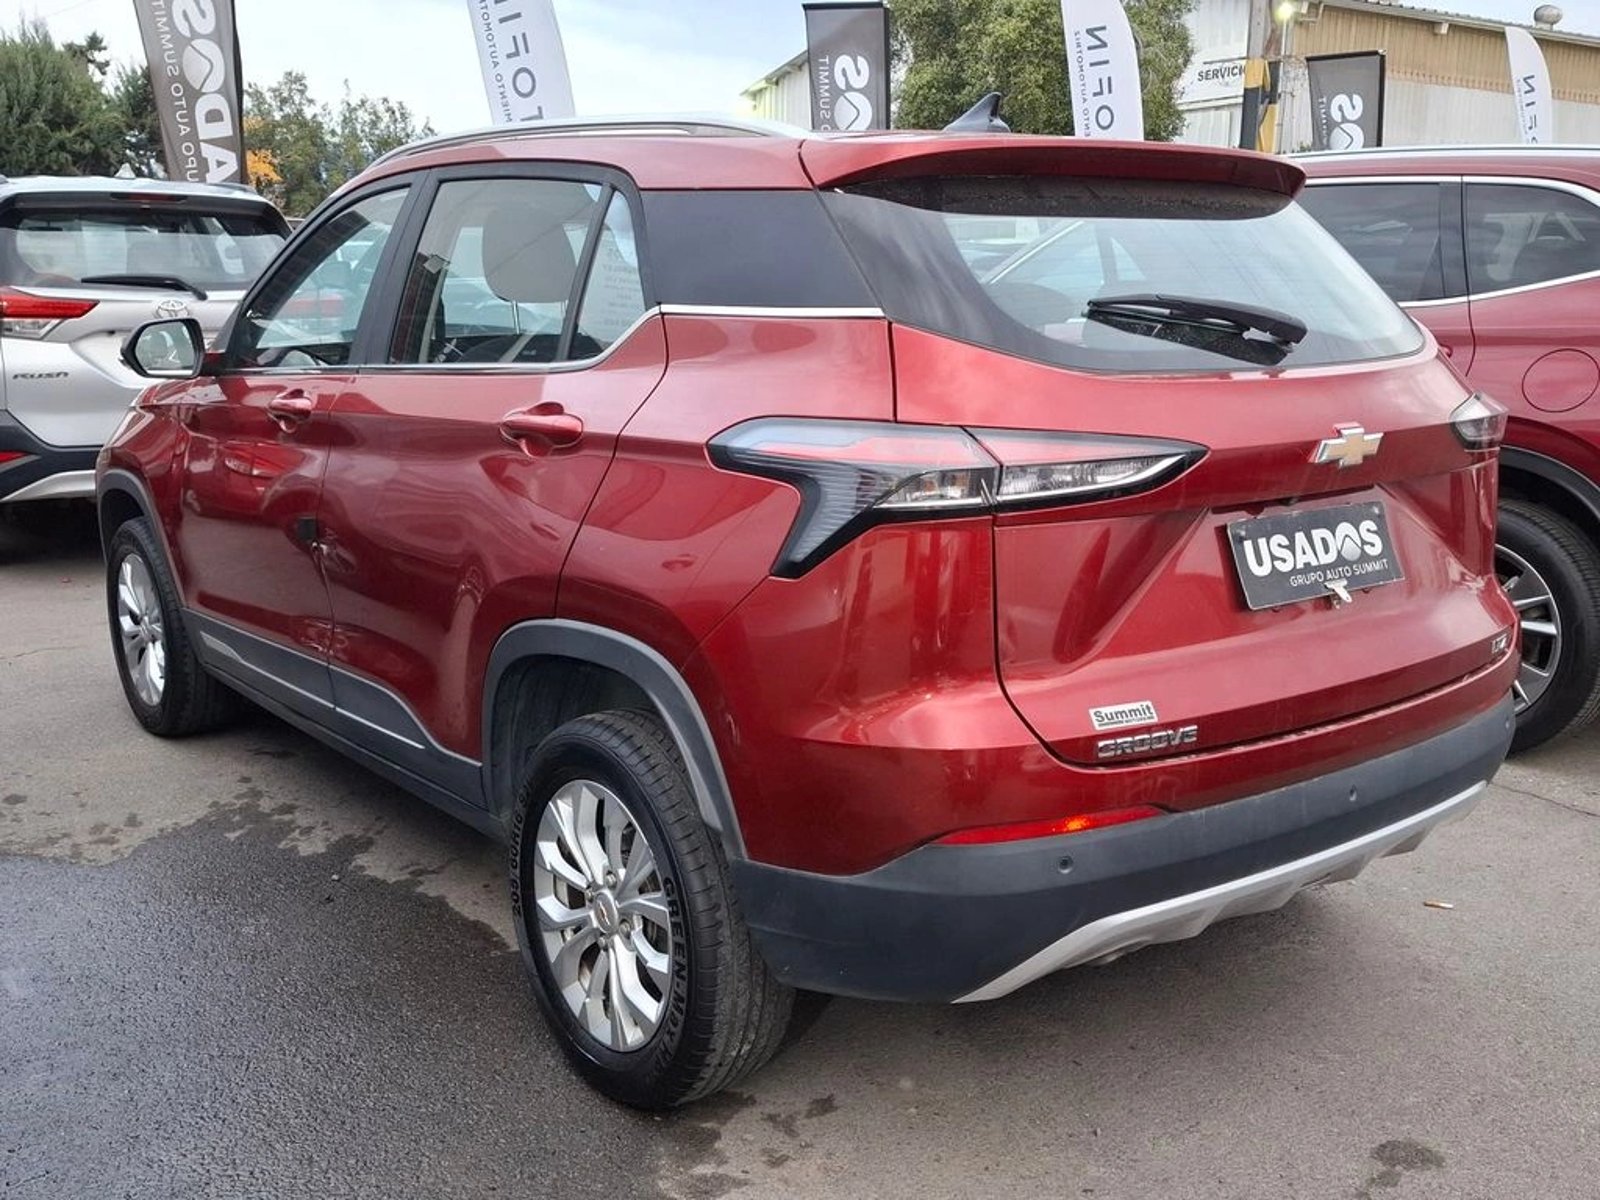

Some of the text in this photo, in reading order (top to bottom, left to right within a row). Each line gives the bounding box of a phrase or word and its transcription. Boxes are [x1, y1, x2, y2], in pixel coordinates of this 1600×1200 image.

[1197, 64, 1246, 82] SERVICI
[1243, 520, 1384, 577] USADOS
[1289, 558, 1389, 587] GRUPO AUTO SUMMIT
[1093, 703, 1154, 723] Summit
